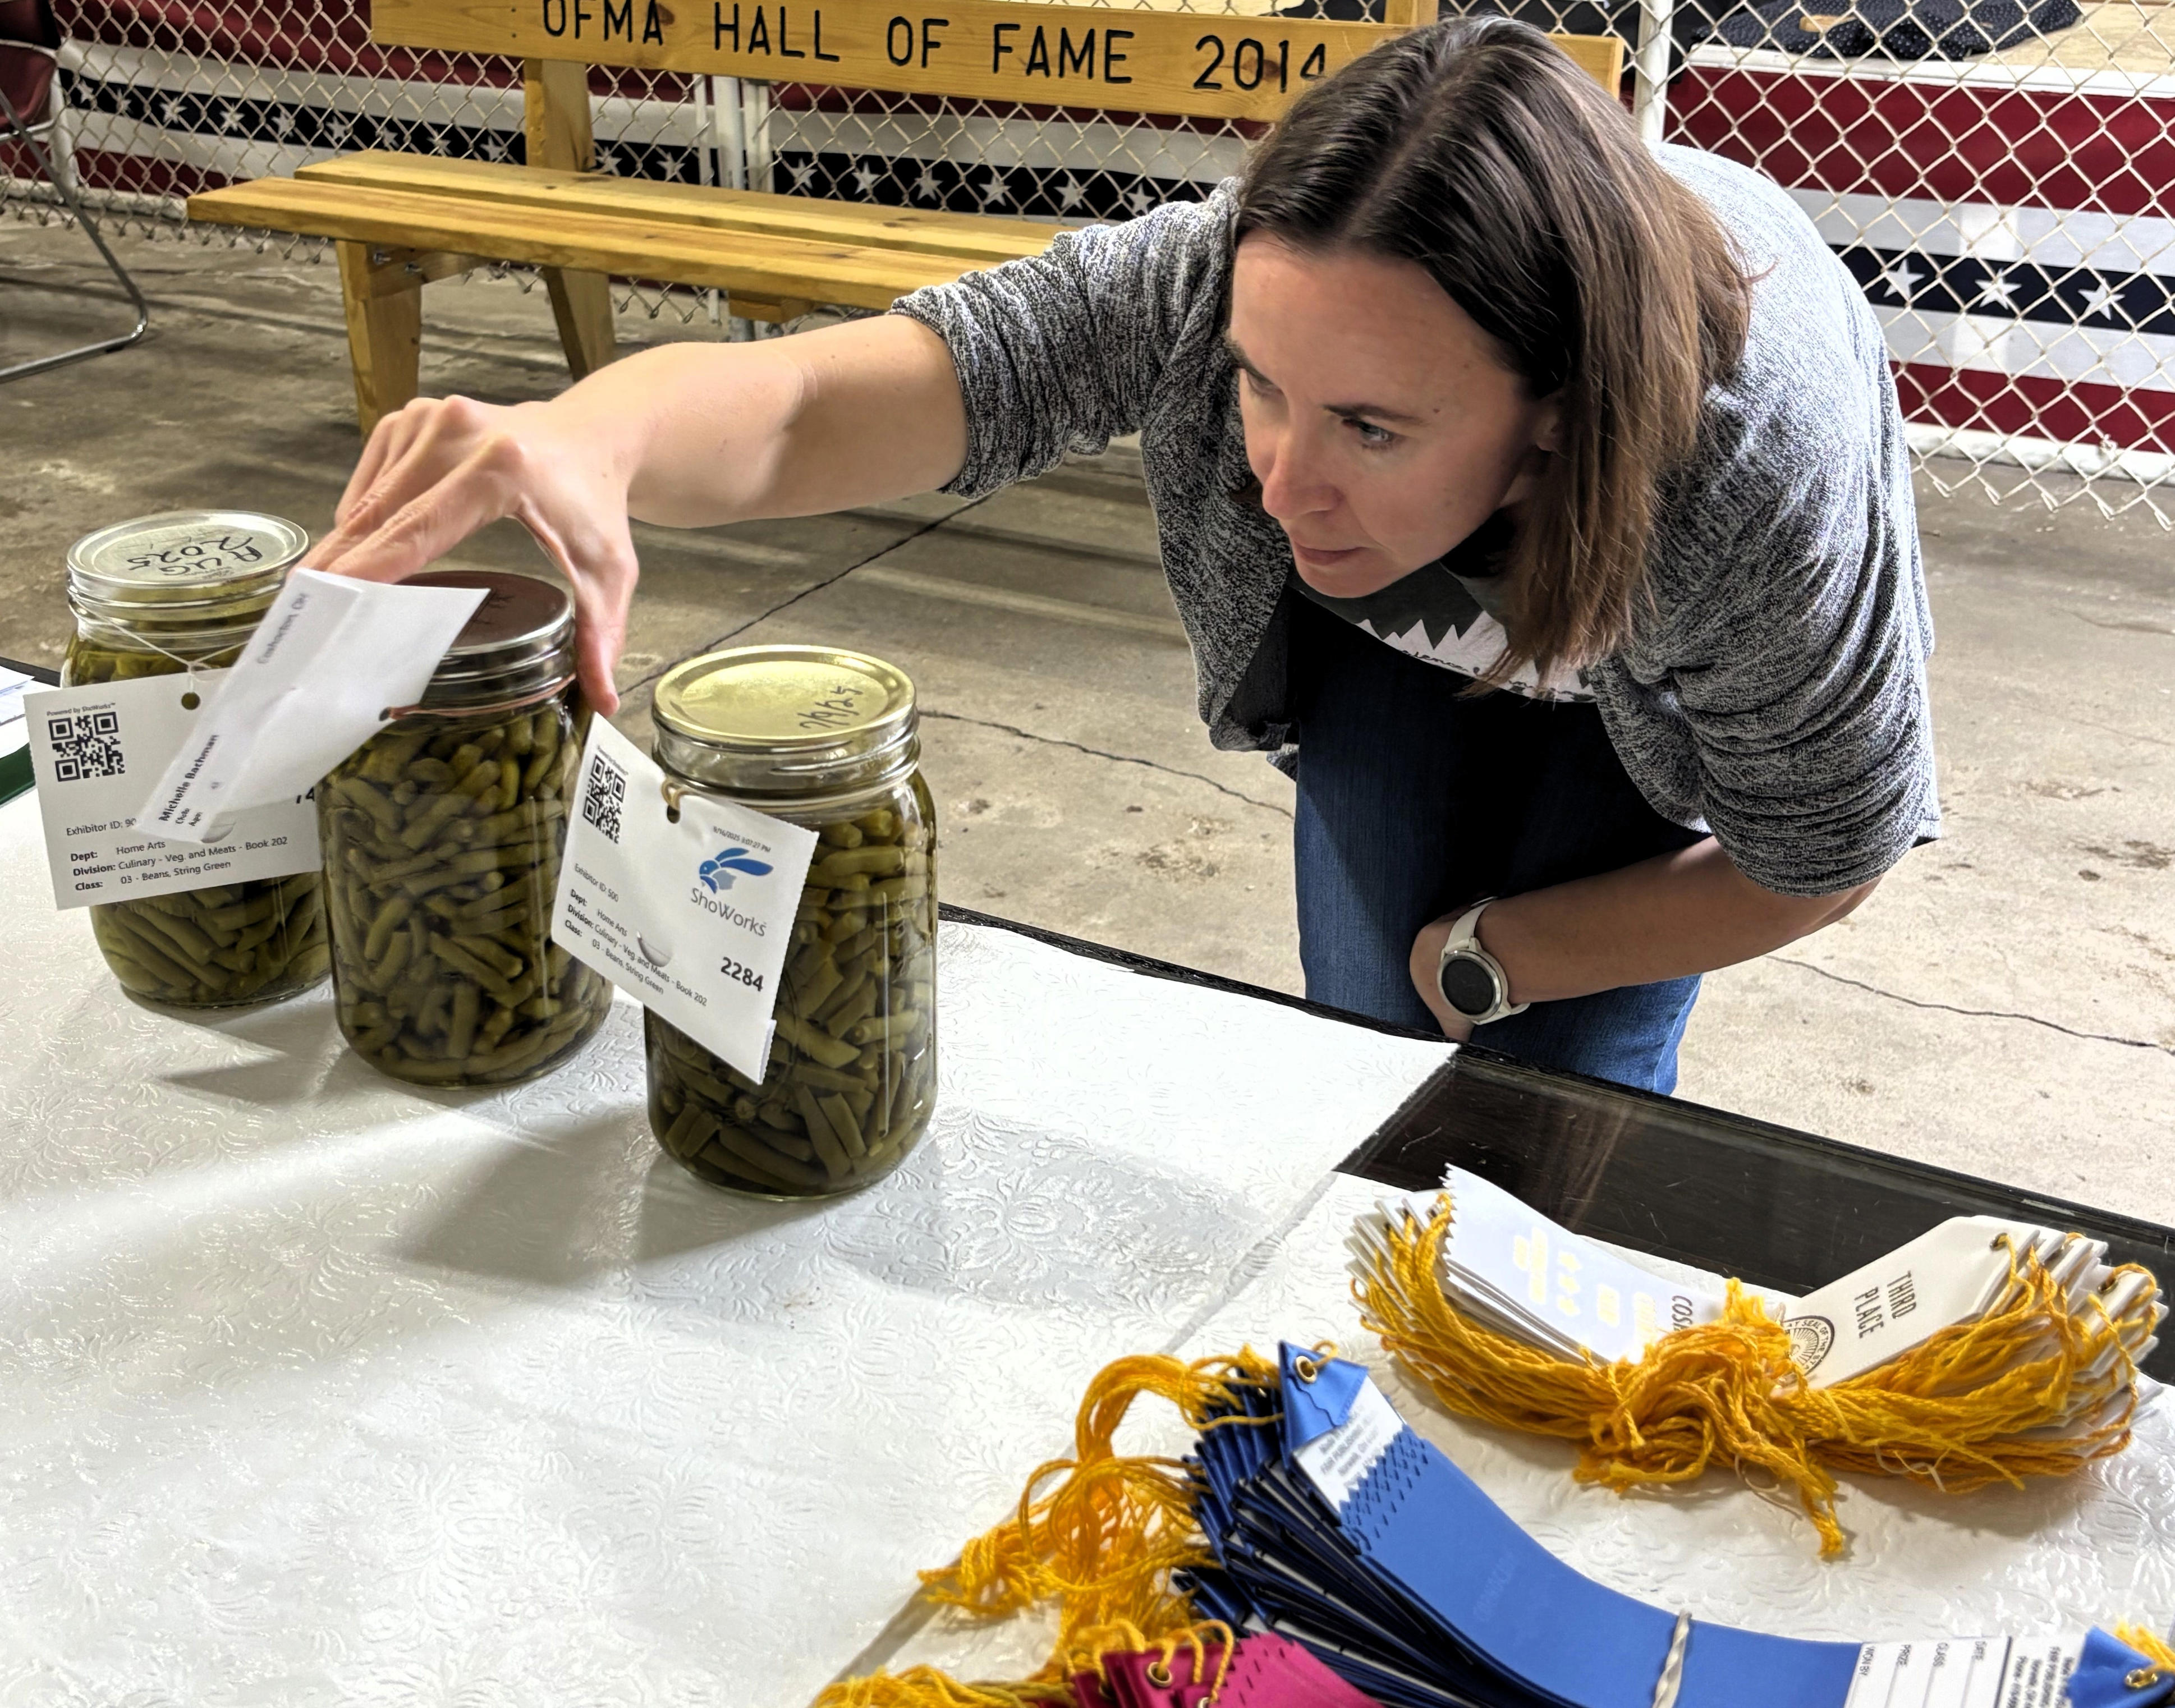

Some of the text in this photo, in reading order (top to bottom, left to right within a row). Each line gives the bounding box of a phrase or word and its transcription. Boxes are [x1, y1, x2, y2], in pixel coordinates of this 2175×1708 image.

[543, 0, 1325, 94] OFMA HALL OF FAME 2014
[126, 536, 253, 571] 2025
[159, 545, 263, 576] AUG
[66, 824, 108, 835] Exhibitor
[110, 821, 123, 829] ID:
[71, 841, 166, 862] Dept: Home Arts
[73, 864, 116, 876] Division:
[118, 858, 155, 870] Culinary
[165, 854, 186, 863] Veg.
[189, 850, 206, 859] and
[209, 845, 236, 856] Meats
[246, 841, 269, 850] Book
[271, 837, 288, 846] 202
[761, 843, 772, 853] PM
[75, 881, 103, 890] Class:
[121, 876, 132, 884] 03
[142, 871, 171, 881] Beans,
[174, 866, 201, 876] String
[204, 861, 231, 871] Green
[575, 864, 598, 886] Exhibitor
[570, 889, 628, 936] Dept: Home Arts
[691, 887, 767, 936] ShoWorks
[565, 920, 583, 937] Class:
[592, 939, 600, 950] 03
[626, 963, 644, 983] String
[645, 977, 664, 995] Green
[568, 904, 594, 929] Division:
[595, 924, 618, 948] Culinary
[637, 955, 650, 969] and
[651, 965, 669, 982] Meats
[676, 980, 692, 998] Book
[695, 993, 708, 1007] 202
[721, 956, 764, 991] 2284
[1887, 1270, 1917, 1319] THIRD
[1854, 1287, 1884, 1339] PLACE
[1859, 1646, 1875, 1676] WON BY
[1896, 1644, 1912, 1667] PRIZE
[1933, 1642, 1949, 1667] CLASS
[1972, 1641, 1987, 1660] DATE
